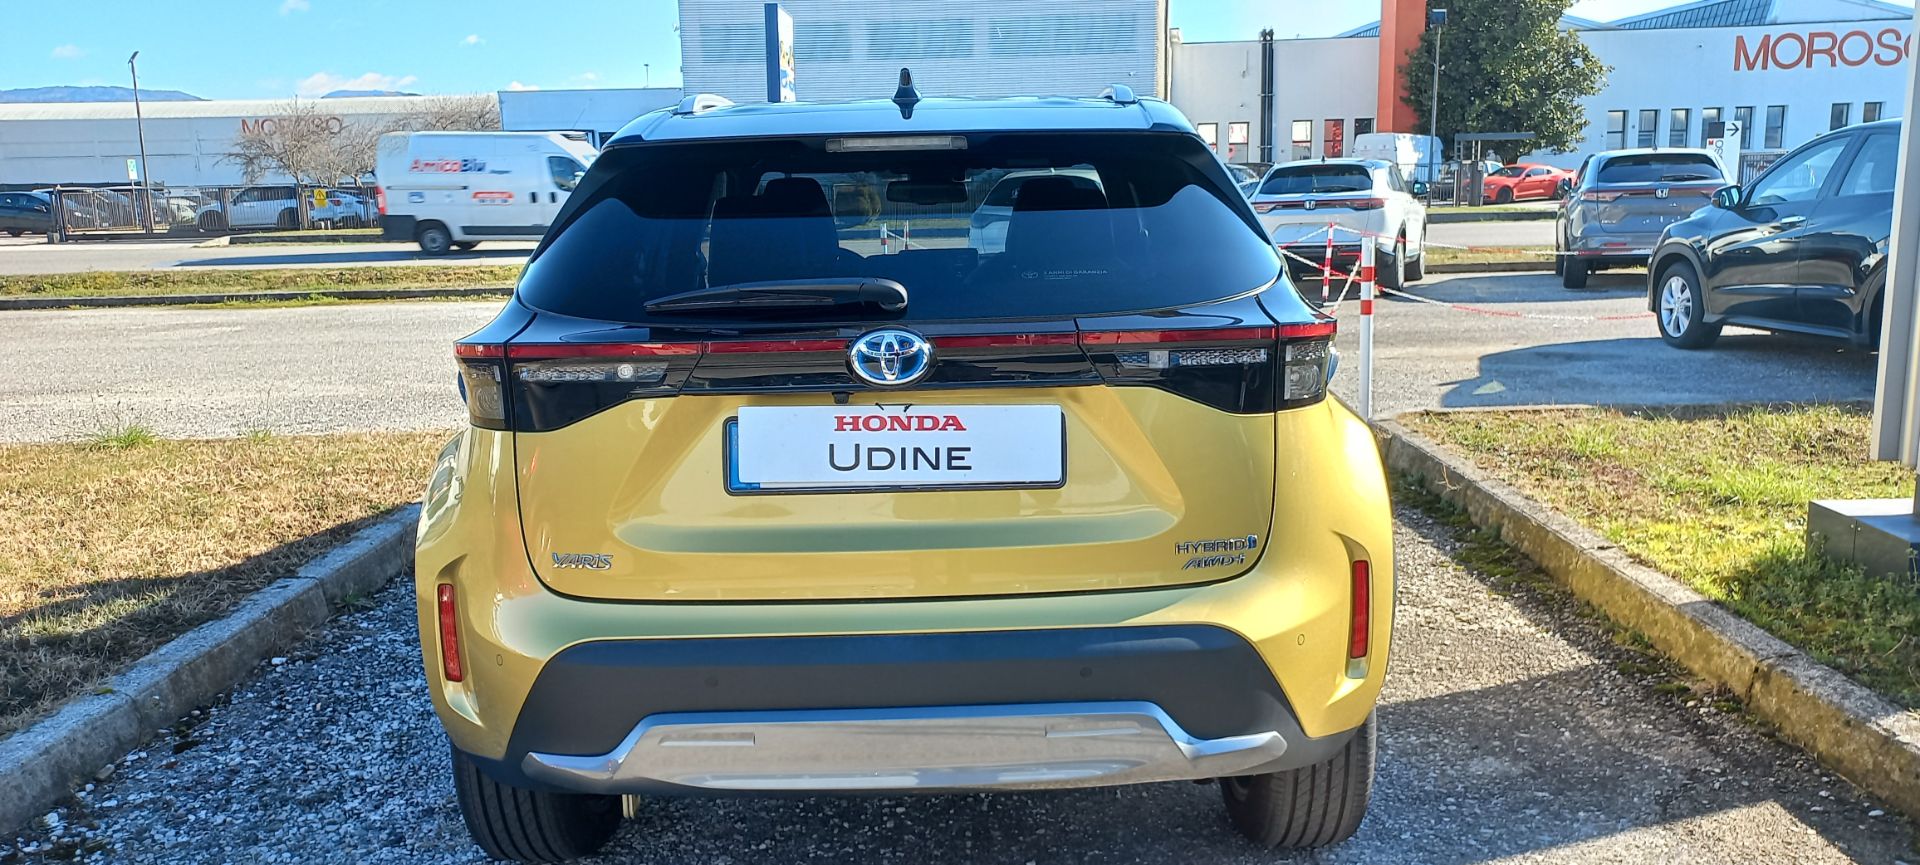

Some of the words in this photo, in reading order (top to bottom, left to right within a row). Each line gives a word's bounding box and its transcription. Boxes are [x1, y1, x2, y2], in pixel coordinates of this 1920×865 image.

[1733, 28, 1912, 71] MOROS
[834, 415, 967, 432] HONDA
[828, 443, 972, 472] UDINE
[1175, 538, 1246, 555] HYBRID
